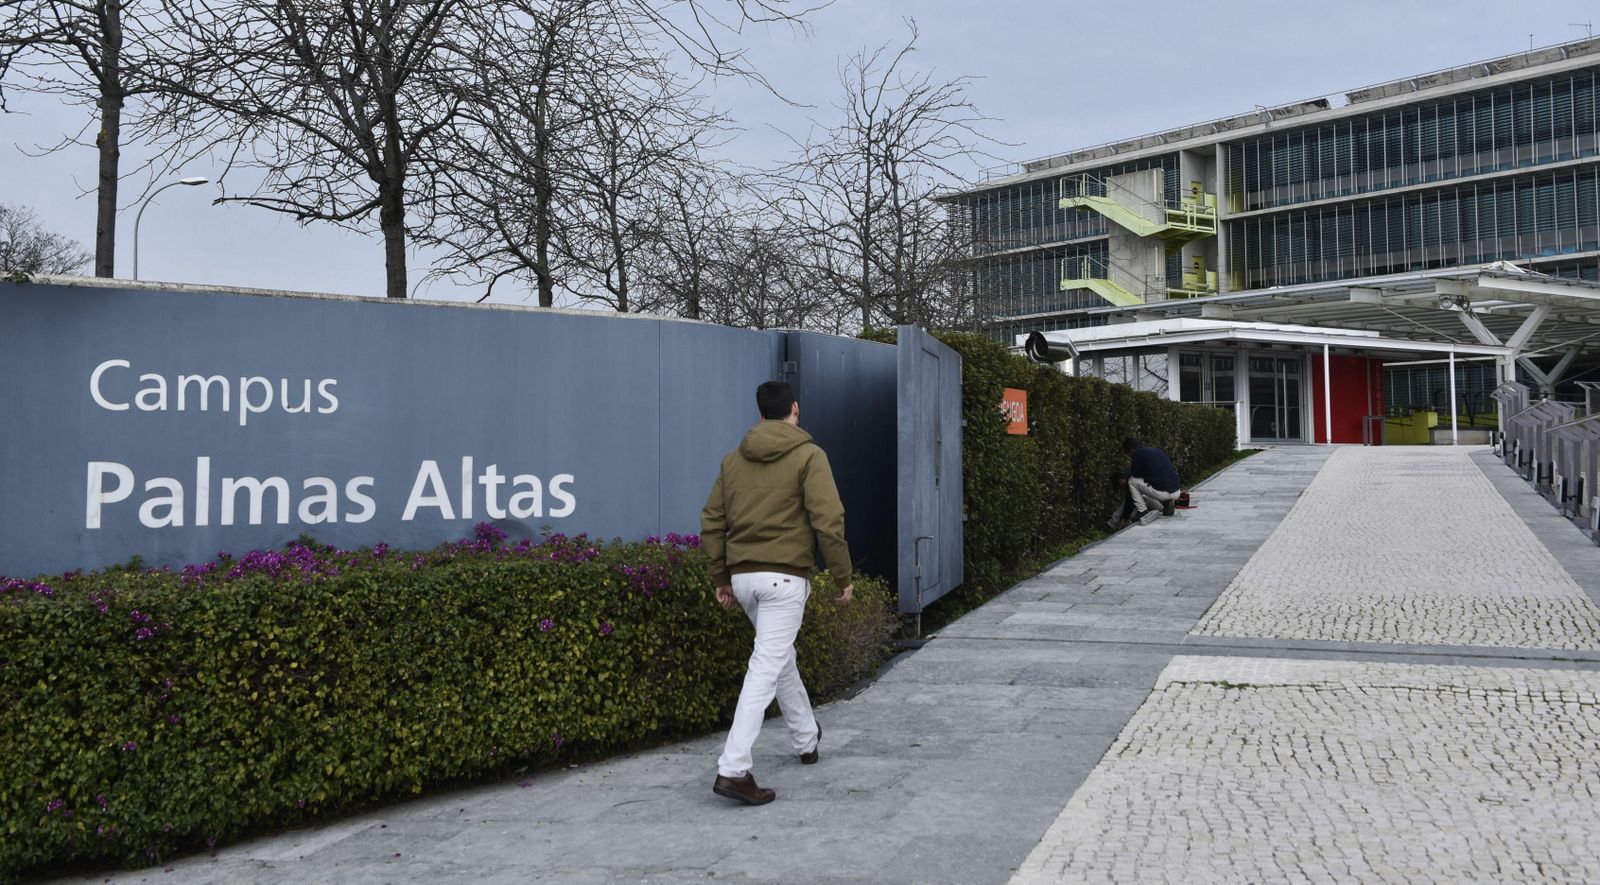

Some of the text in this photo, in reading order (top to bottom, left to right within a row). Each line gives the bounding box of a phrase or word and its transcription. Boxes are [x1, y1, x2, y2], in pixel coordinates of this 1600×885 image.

[89, 359, 339, 426] Campus
[85, 456, 576, 529] Palmas Altas
